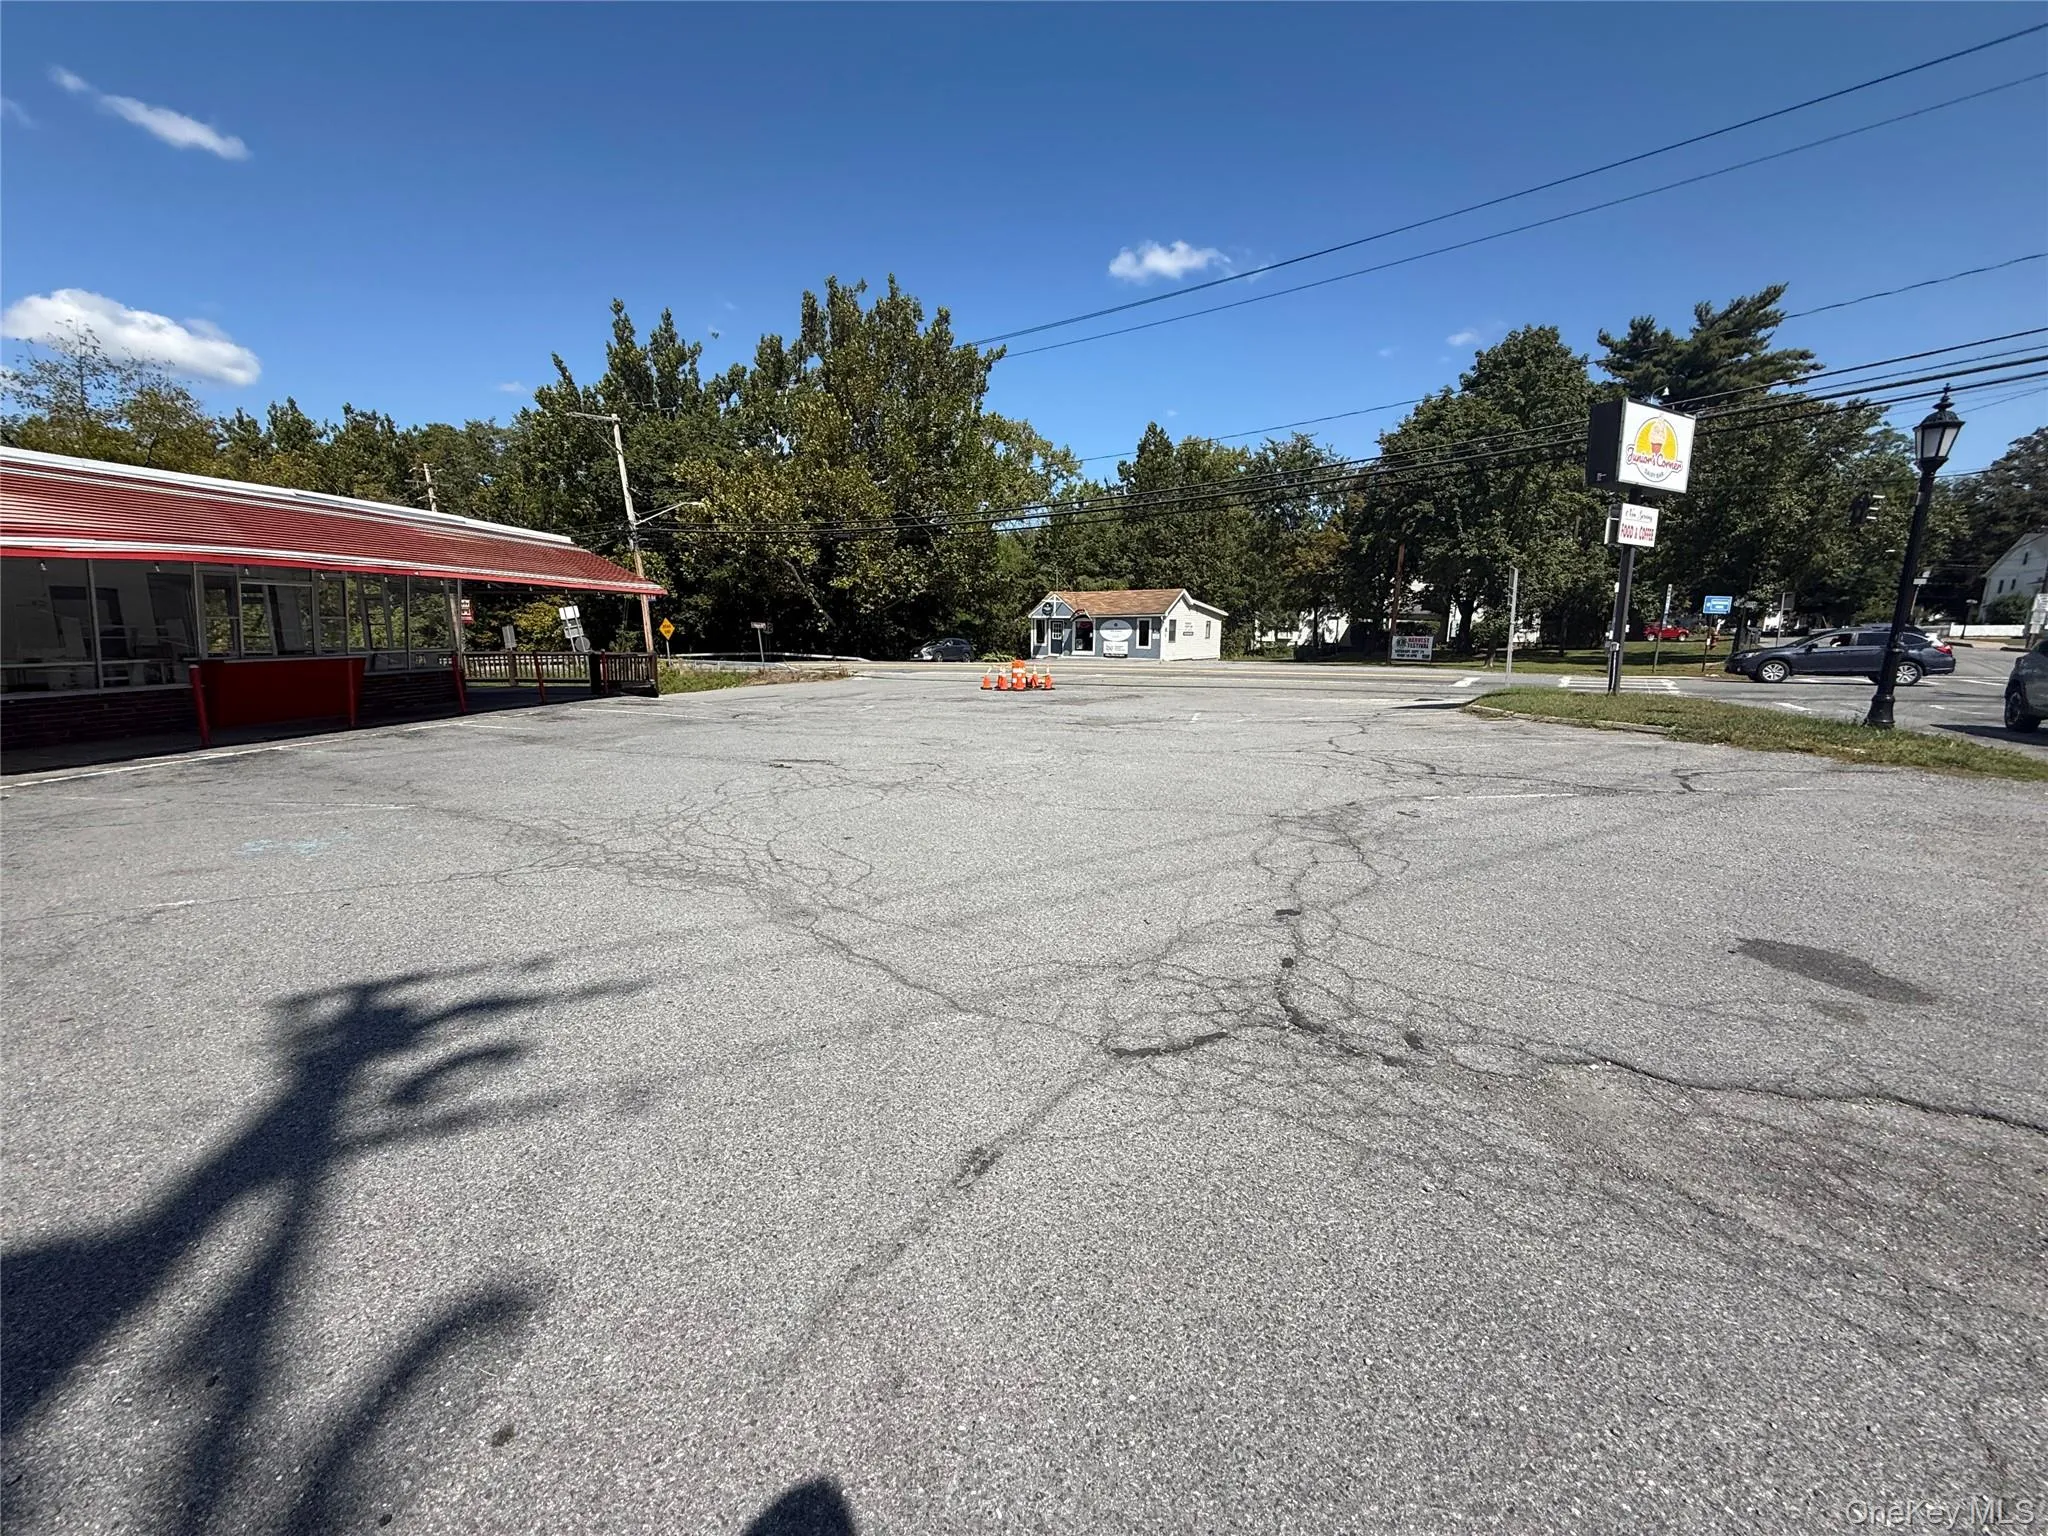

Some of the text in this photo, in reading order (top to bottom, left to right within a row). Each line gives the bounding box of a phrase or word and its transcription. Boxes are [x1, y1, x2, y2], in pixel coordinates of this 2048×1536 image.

[1657, 453, 1682, 470] Corner
[1621, 523, 1634, 538] FOOD
[1639, 526, 1654, 541] COFFEE
